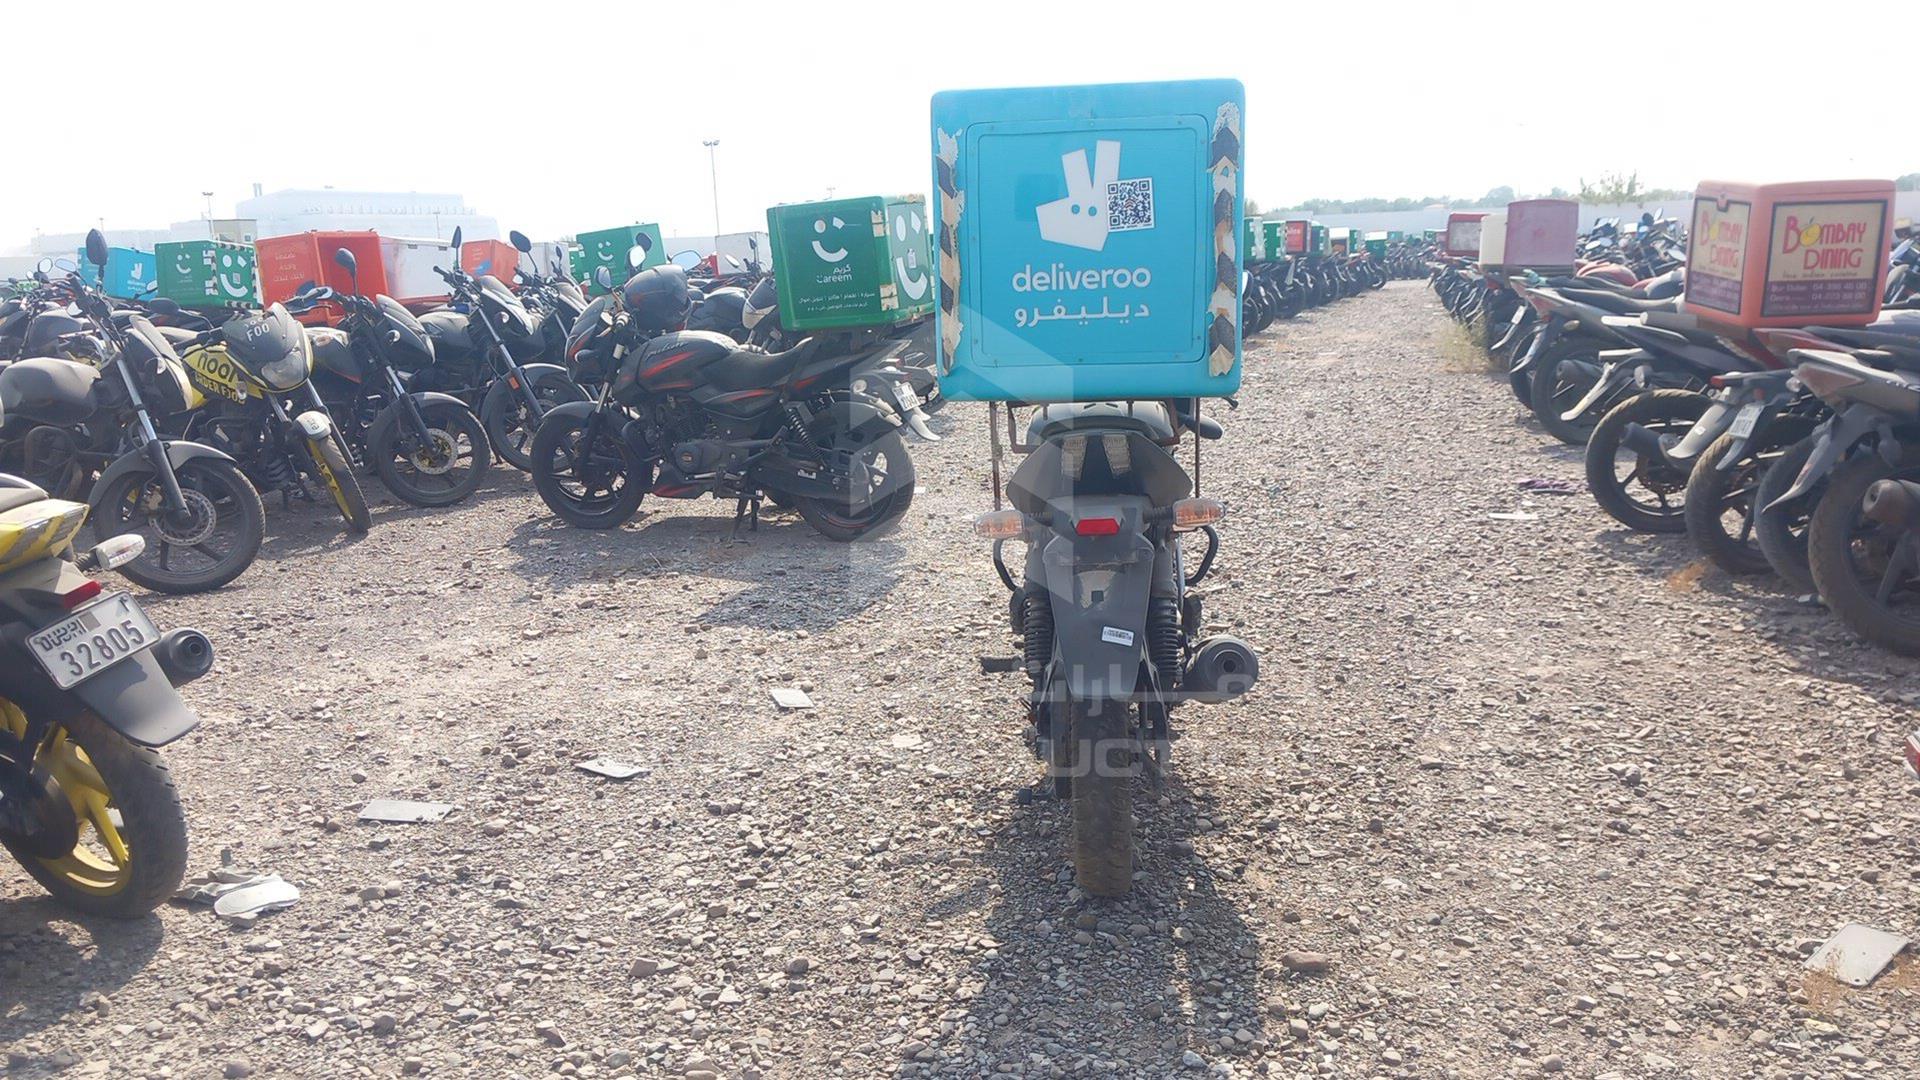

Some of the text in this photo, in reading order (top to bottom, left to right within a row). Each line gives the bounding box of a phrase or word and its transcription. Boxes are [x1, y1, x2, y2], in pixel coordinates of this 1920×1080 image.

[1803, 248, 1864, 270] DINING
[1012, 263, 1152, 292] deliveroo
[1014, 296, 1150, 327] ديليفرو
[60, 619, 144, 676] 32805
